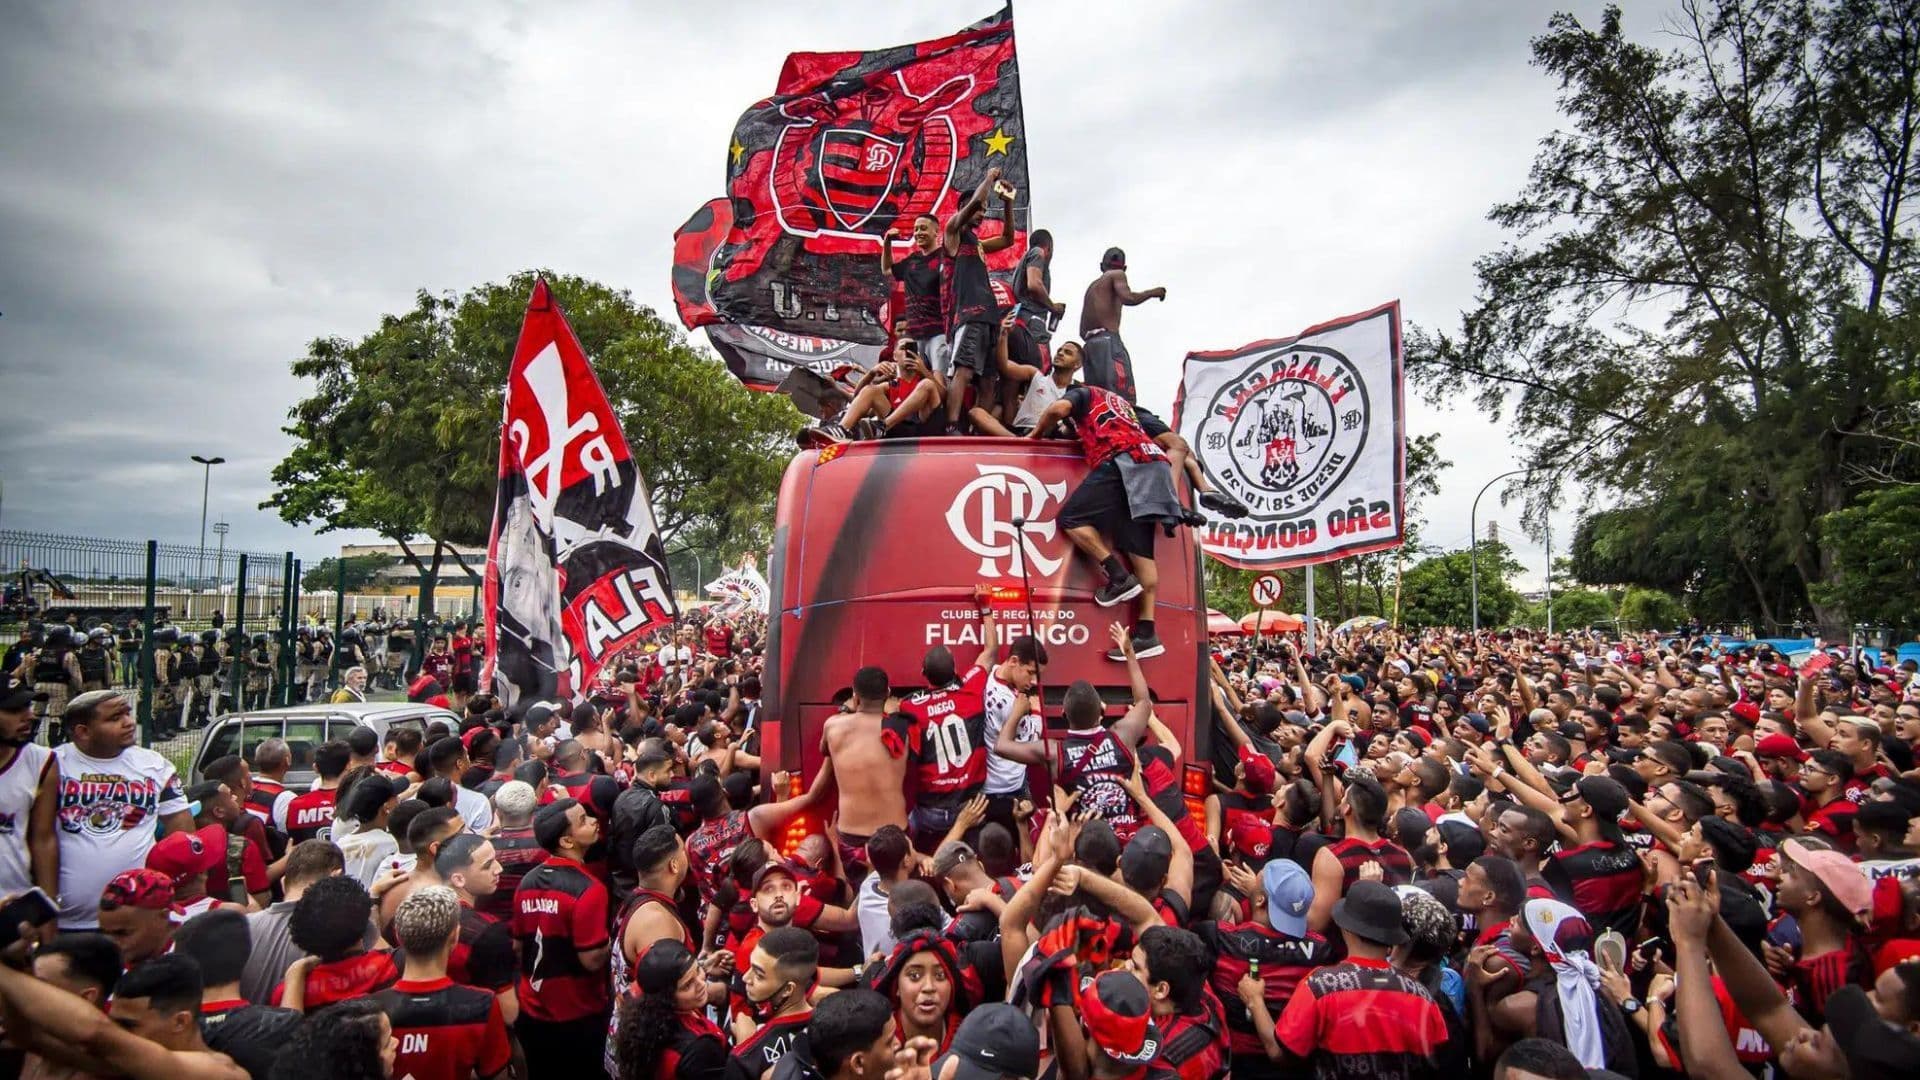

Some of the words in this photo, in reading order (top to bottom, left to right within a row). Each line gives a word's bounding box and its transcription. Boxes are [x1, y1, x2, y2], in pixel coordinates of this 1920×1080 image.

[941, 610, 979, 619] CLUBE
[992, 610, 999, 619] E
[1058, 610, 1075, 619] DO
[927, 700, 956, 717] DIEGO
[926, 713, 972, 774] 10
[62, 776, 156, 815] BUZADA
[297, 806, 336, 825] MR
[401, 1033, 429, 1054] DN
